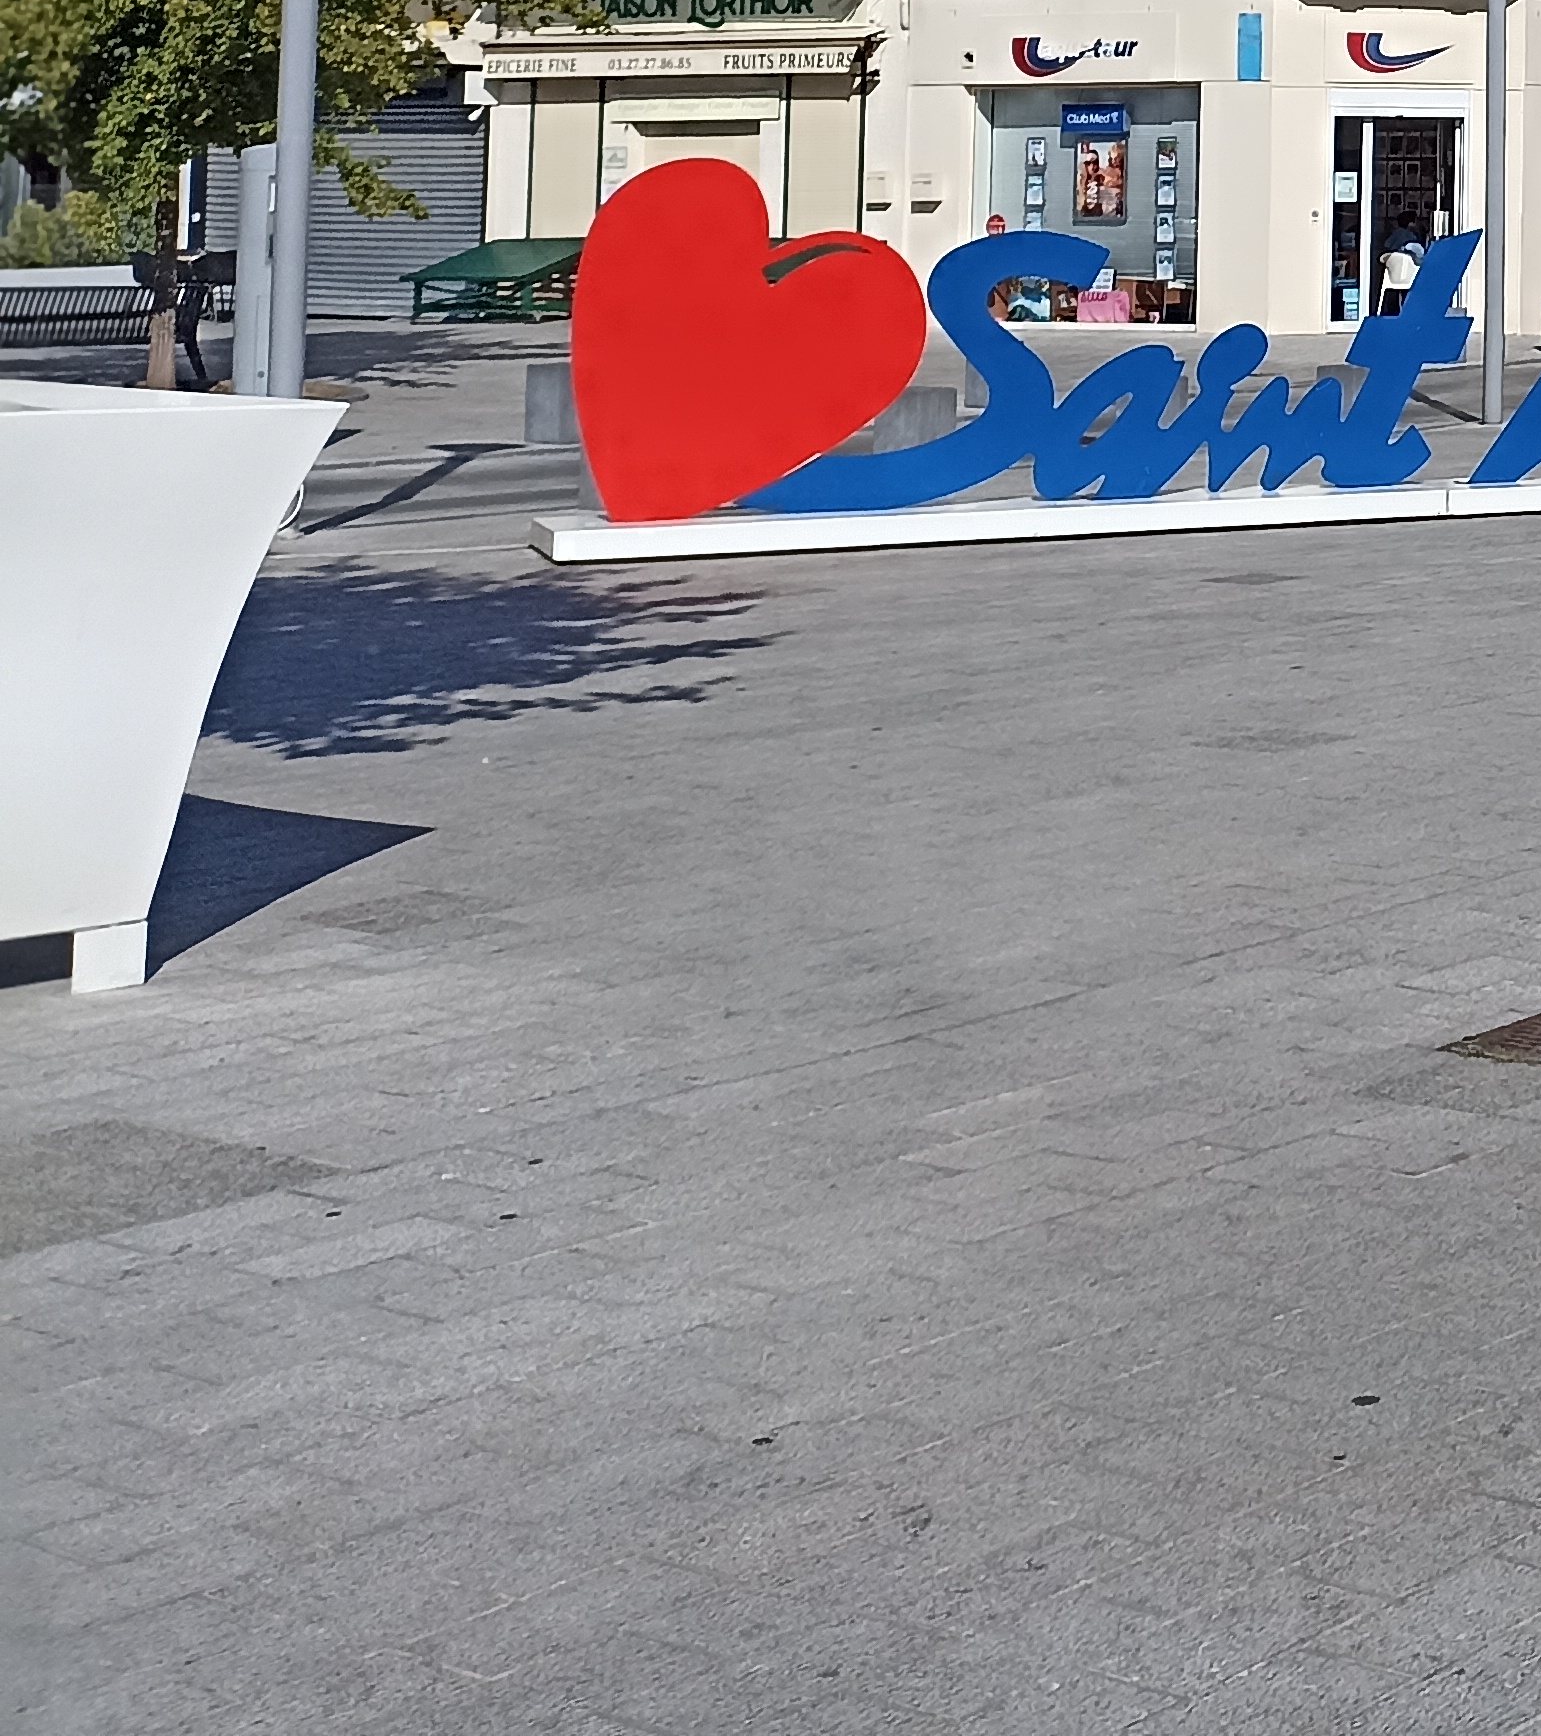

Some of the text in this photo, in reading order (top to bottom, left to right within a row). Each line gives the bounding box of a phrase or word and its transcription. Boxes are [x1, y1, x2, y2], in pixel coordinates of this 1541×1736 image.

[487, 59, 543, 74] EPICERIE
[548, 58, 577, 73] FINE
[723, 53, 774, 70] FRUITS
[779, 52, 854, 69] PRIMEURS
[1066, 113, 1110, 124] Club Med
[735, 228, 1484, 513] Saint
